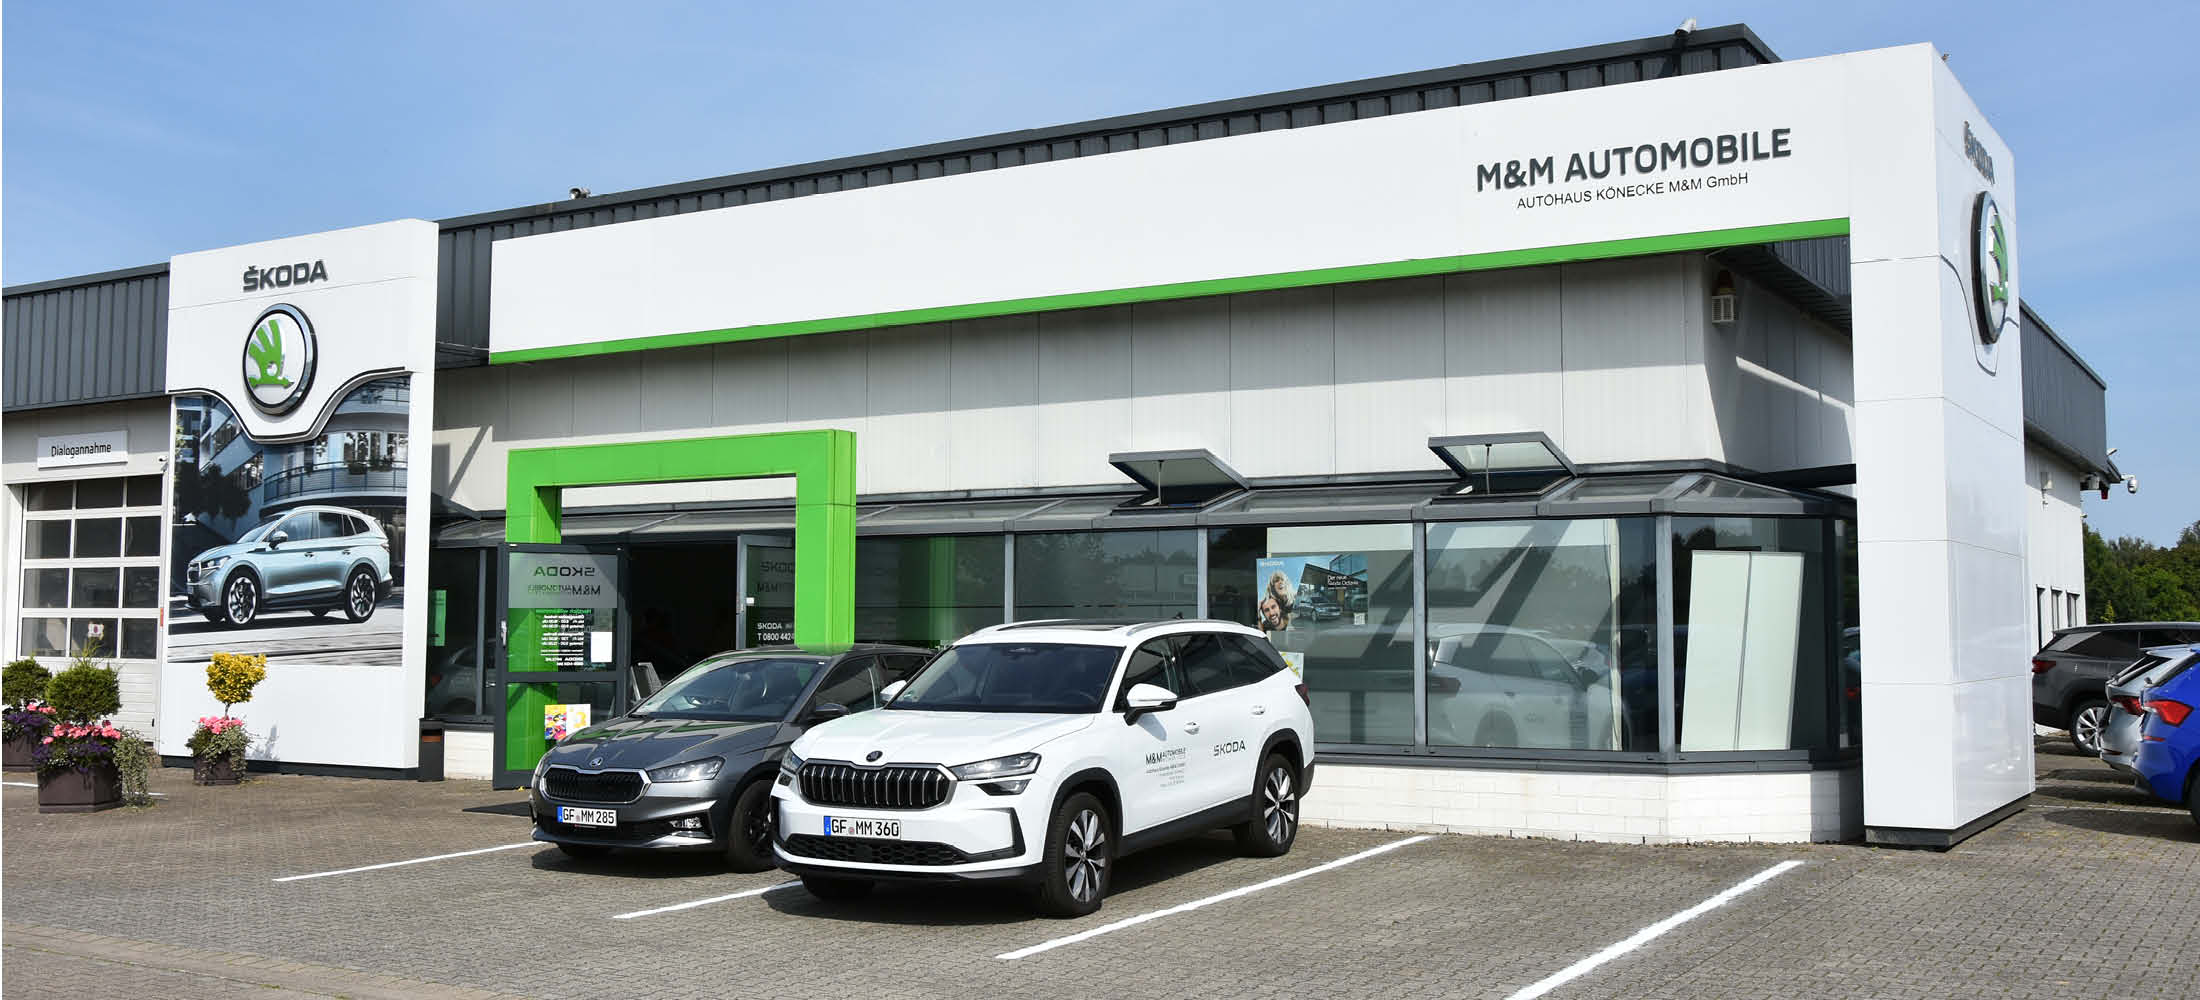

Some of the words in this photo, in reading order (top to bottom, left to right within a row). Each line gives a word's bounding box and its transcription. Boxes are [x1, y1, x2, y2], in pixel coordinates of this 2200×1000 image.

[1477, 157, 1554, 192] M&M
[1565, 128, 1793, 183] AUTOMOBILE
[1517, 190, 1592, 209] AUTOHAUS
[1597, 181, 1664, 200] KÖNECKE
[1669, 176, 1702, 193] M&M
[1706, 172, 1749, 188] GmbH
[243, 259, 328, 293] ŠKODA
[51, 441, 112, 459] Dialogannahme
[757, 632, 762, 641] T
[762, 632, 780, 641] 0800
[1145, 751, 1162, 765] M&M
[563, 808, 575, 821] GF
[581, 809, 594, 823] MM
[596, 810, 615, 824] 285
[831, 818, 848, 834] GF
[855, 820, 873, 836] MM
[875, 821, 899, 837] 360
